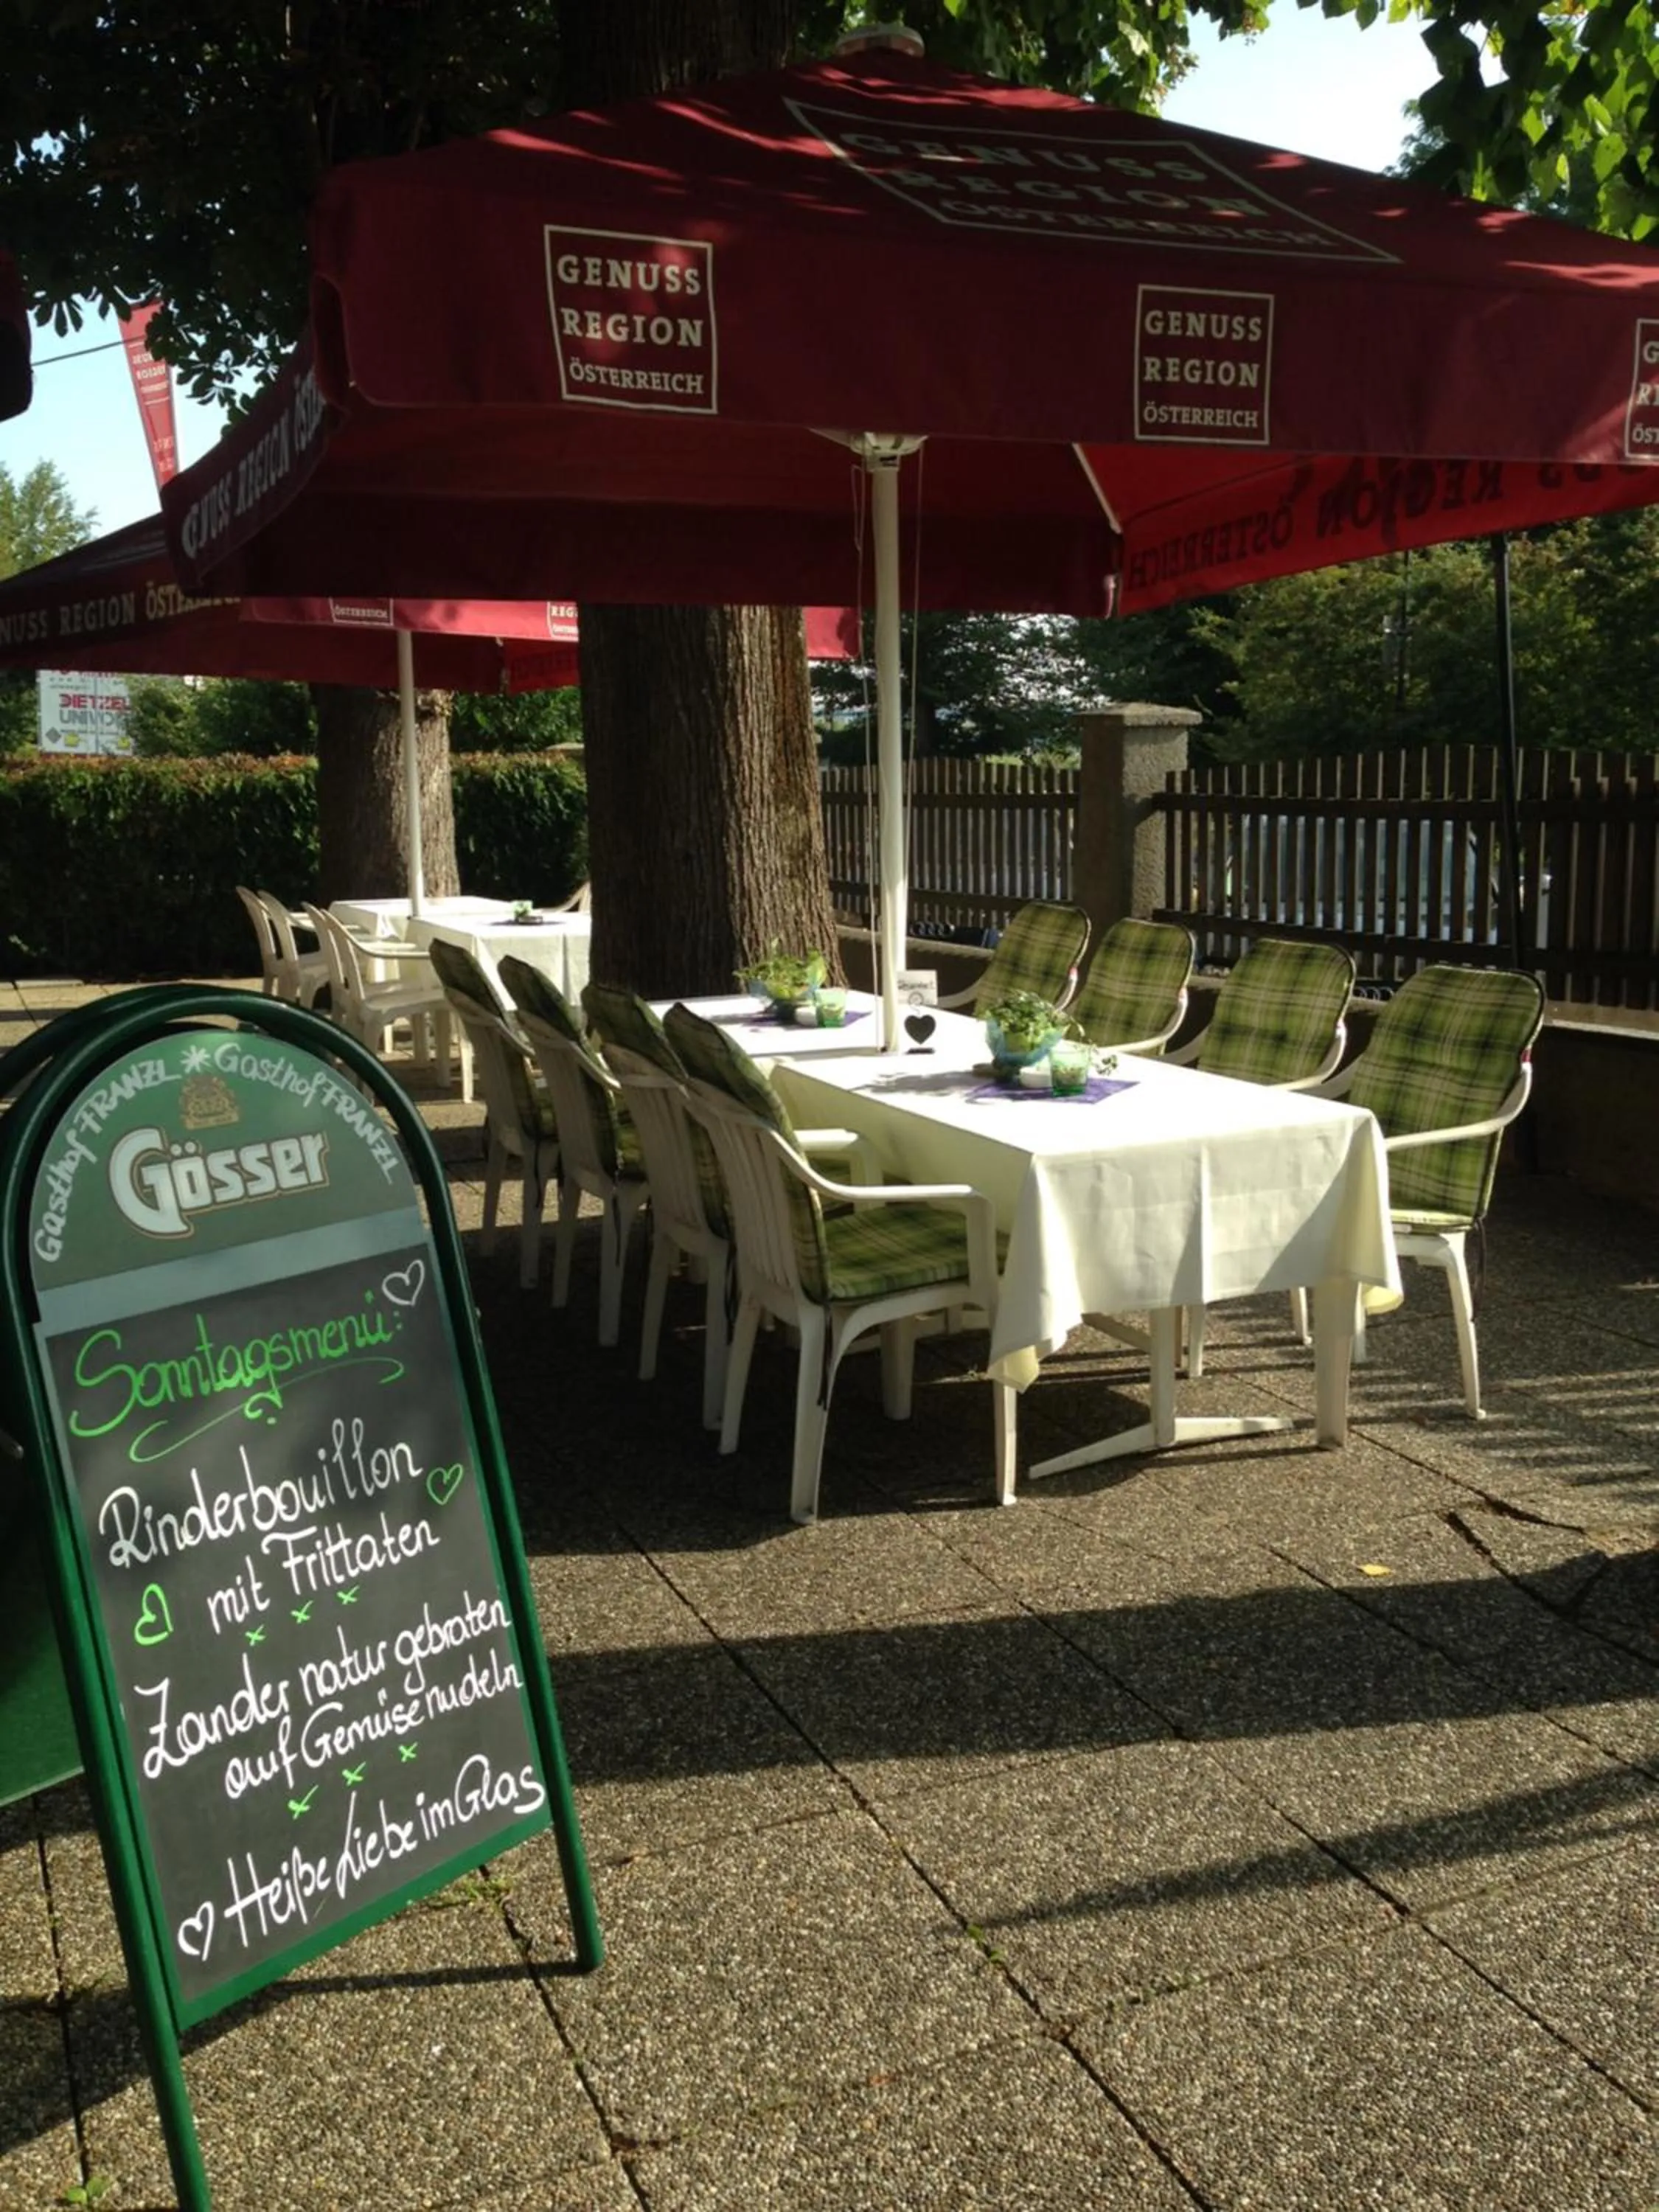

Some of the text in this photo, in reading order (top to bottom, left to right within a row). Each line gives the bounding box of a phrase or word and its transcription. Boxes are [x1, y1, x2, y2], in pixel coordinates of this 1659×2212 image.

[840, 131, 1208, 182] GENUSS
[888, 167, 1268, 217] REGION
[557, 254, 701, 295] GENUSS
[560, 307, 703, 347] REGION
[1144, 310, 1262, 341] GENUSS
[569, 356, 704, 394] ÖSTERREICH
[1144, 355, 1259, 387] REGION
[1144, 400, 1259, 428] ÖSTERREICH
[59, 593, 135, 636] REGION
[213, 1042, 399, 1186] Gasthof FRANZL
[34, 1059, 182, 1262] Gasthof FRANZL
[110, 1128, 327, 1235] Gösser
[99, 1417, 422, 1568] Rinderbouillon
[207, 1512, 440, 1632] mit Frittaten
[134, 1590, 512, 1778] Zander natur gebraten
[225, 1715, 297, 1798] auf
[224, 1846, 331, 1947] Heiße
[335, 1790, 418, 1899] Liebe
